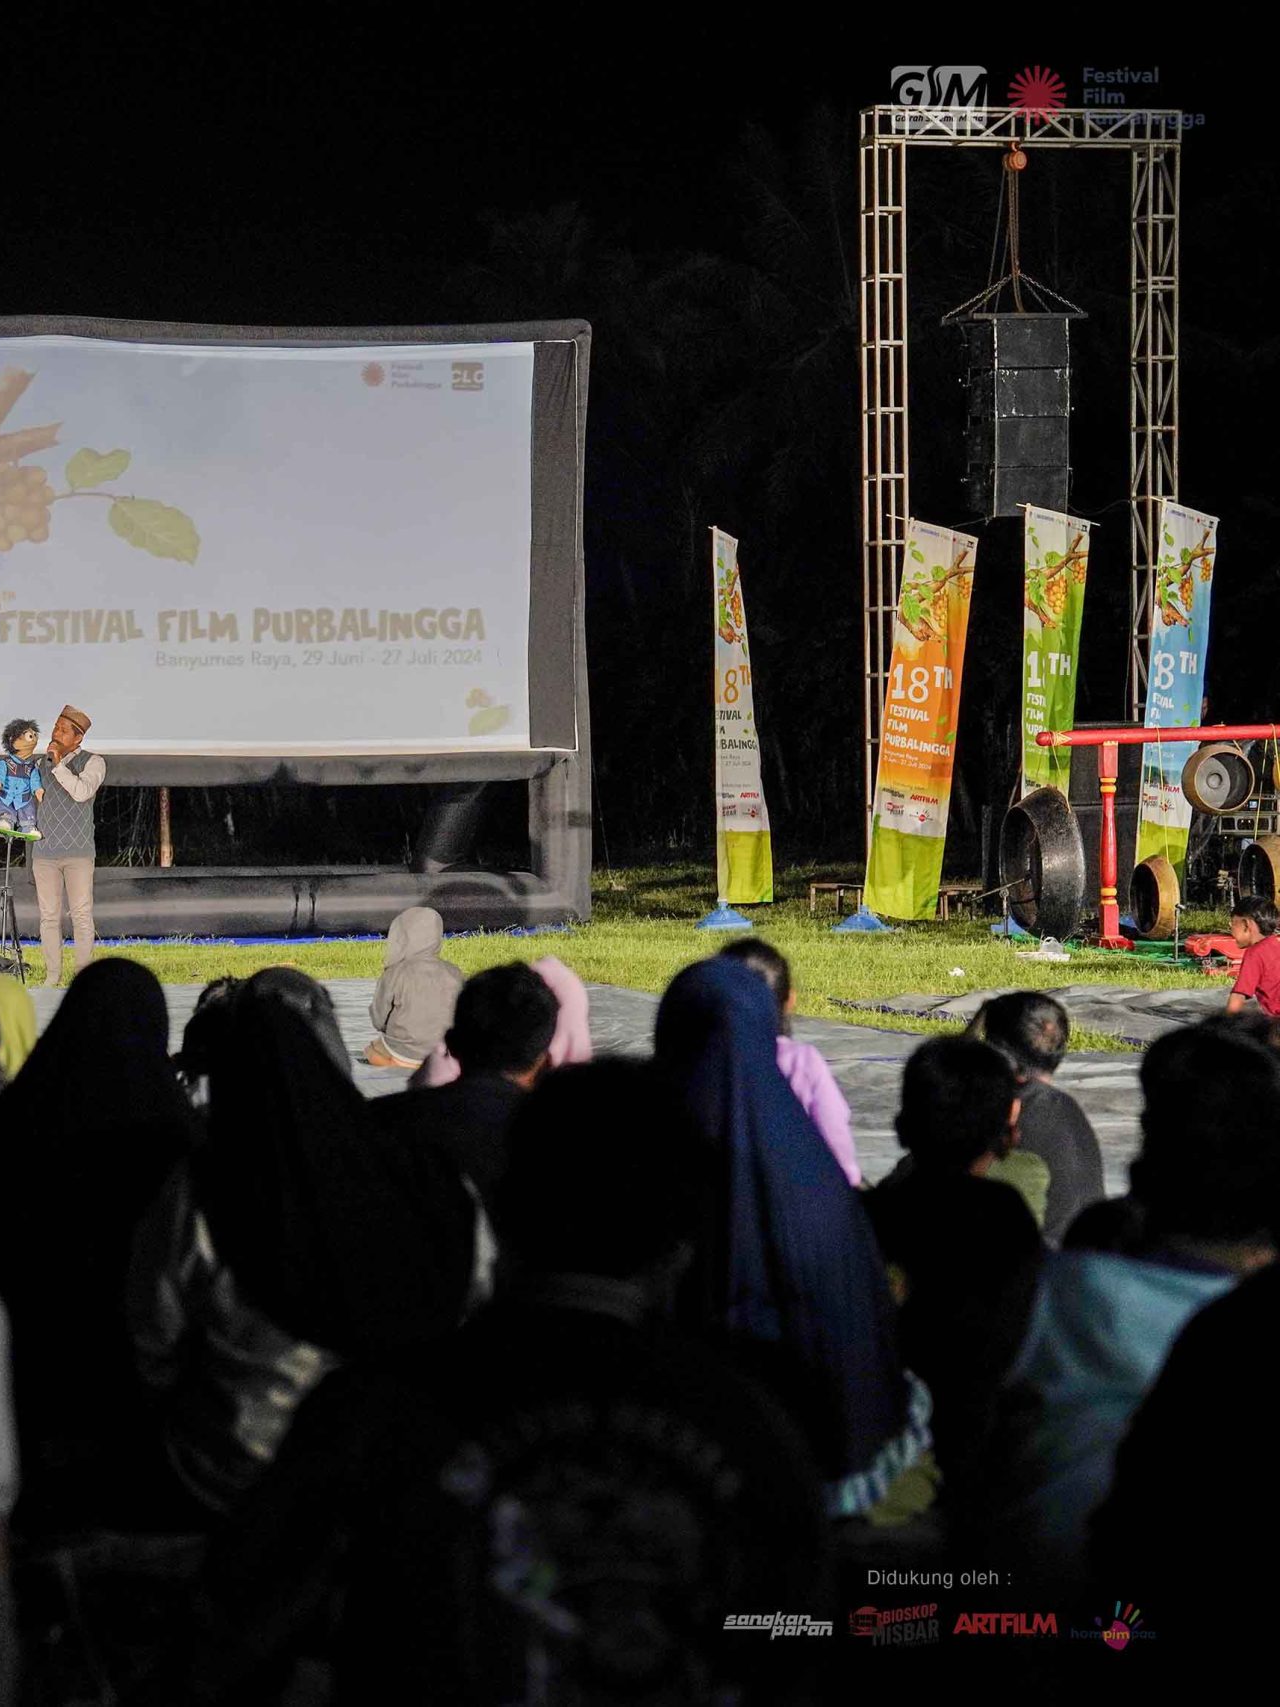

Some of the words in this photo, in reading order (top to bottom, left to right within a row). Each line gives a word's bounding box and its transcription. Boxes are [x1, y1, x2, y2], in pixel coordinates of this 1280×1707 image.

[158, 609, 238, 642] FILM
[252, 607, 485, 643] PURBALINGGA
[156, 651, 244, 671] Banyumas
[303, 650, 323, 665] 29
[328, 650, 363, 665] Juni
[382, 650, 402, 665] 27
[407, 650, 437, 665] Juli
[443, 649, 482, 665] 2024
[1027, 651, 1071, 687] 1TH
[891, 664, 953, 703] 18TH
[889, 704, 930, 722] FESTIVAL
[887, 718, 908, 734] FILM
[884, 732, 951, 757] PURBALINGGA
